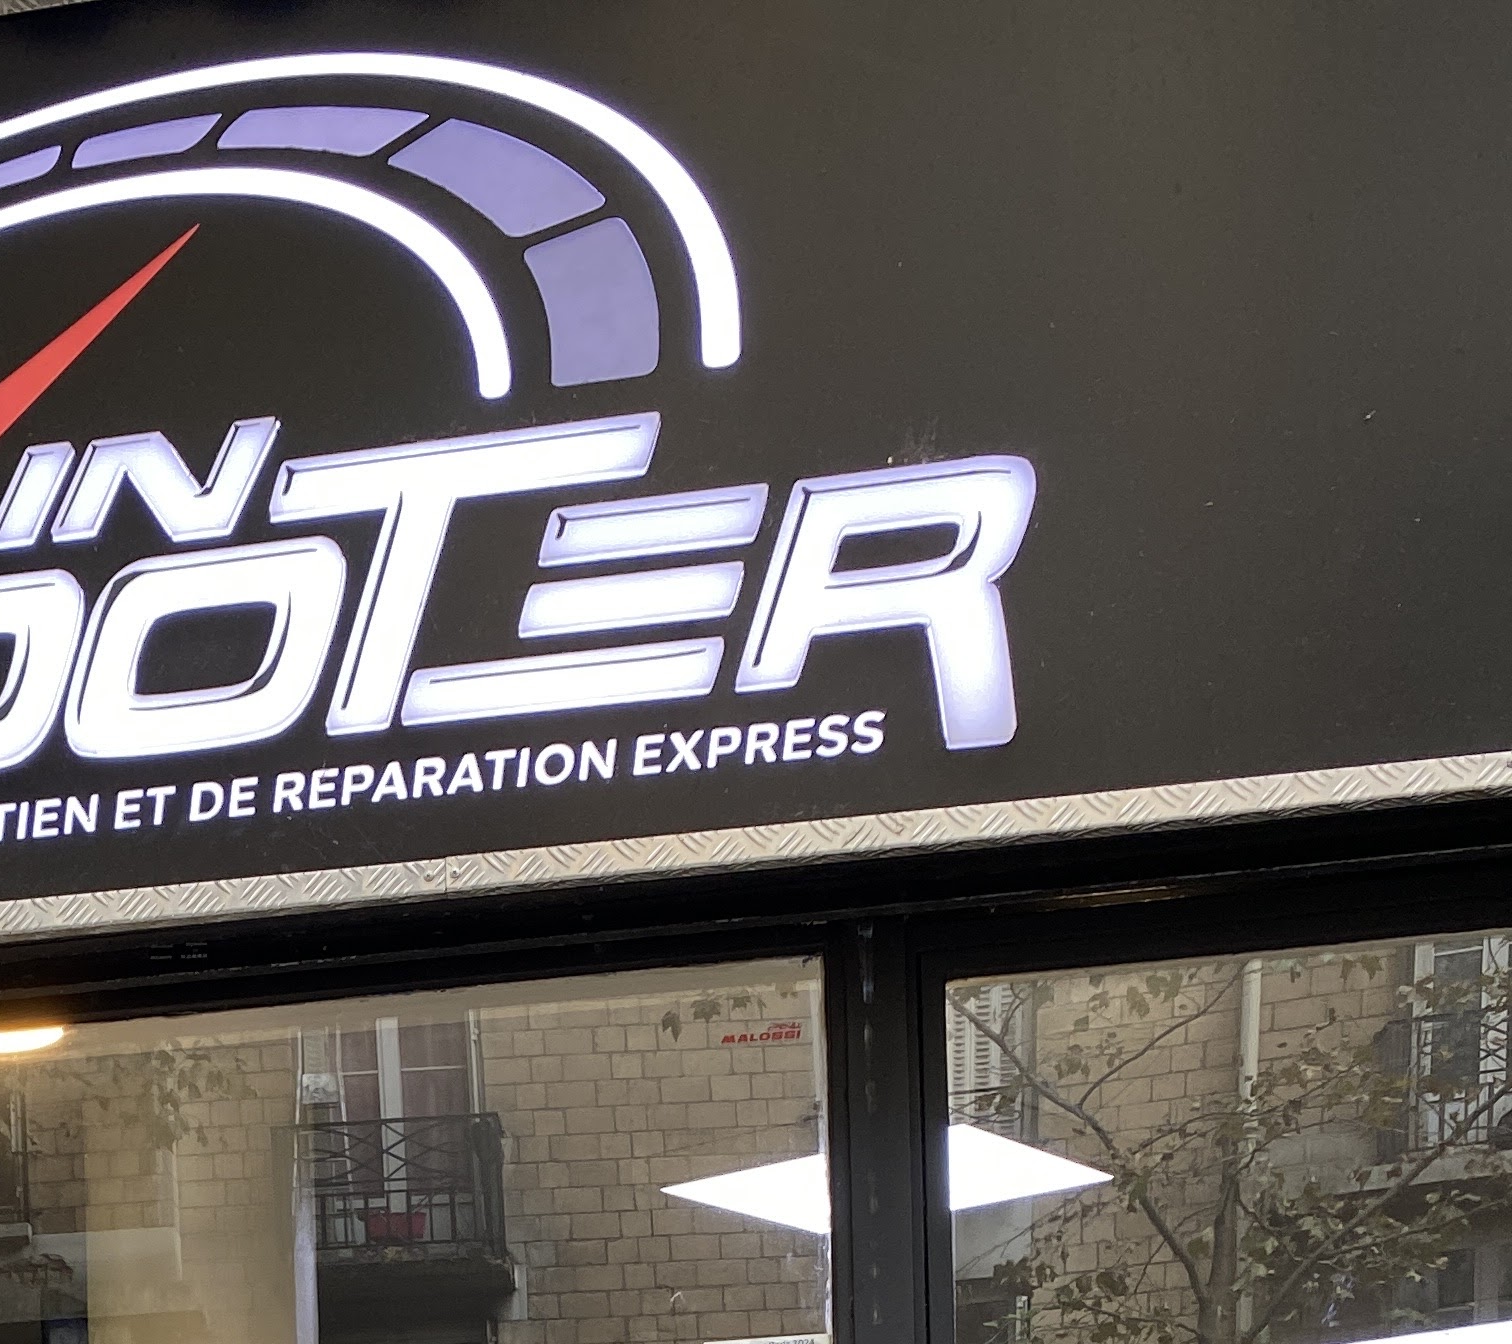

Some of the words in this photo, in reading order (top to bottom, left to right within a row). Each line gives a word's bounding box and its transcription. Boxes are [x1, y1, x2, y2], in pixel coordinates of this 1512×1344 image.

[114, 786, 174, 831] ET
[186, 778, 258, 826] DE
[272, 743, 614, 816] REPARATION
[631, 711, 884, 780] EXPRESS
[721, 1030, 801, 1045] MALOSSI
